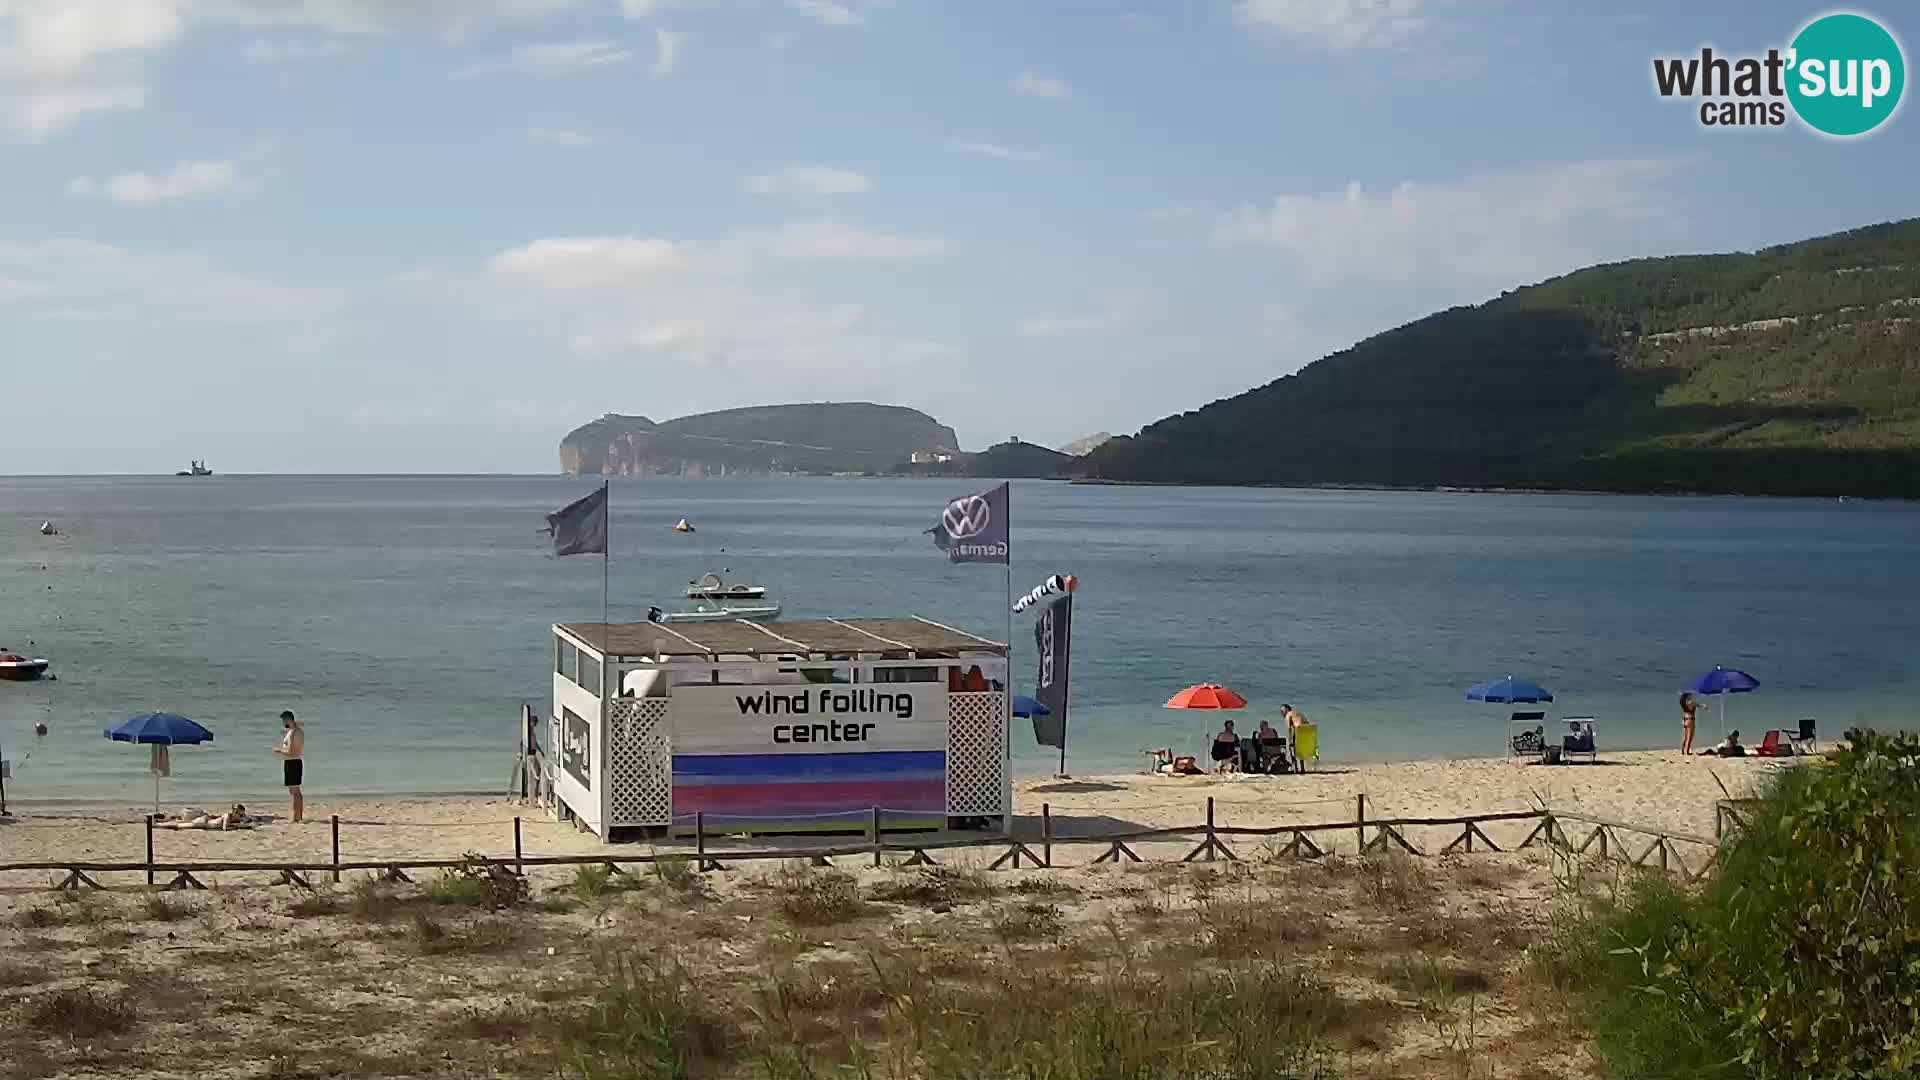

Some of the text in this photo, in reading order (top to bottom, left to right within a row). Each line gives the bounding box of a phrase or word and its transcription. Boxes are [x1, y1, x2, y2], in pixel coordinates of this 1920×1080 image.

[735, 688, 913, 719] wind foiling
[773, 719, 876, 744] center
